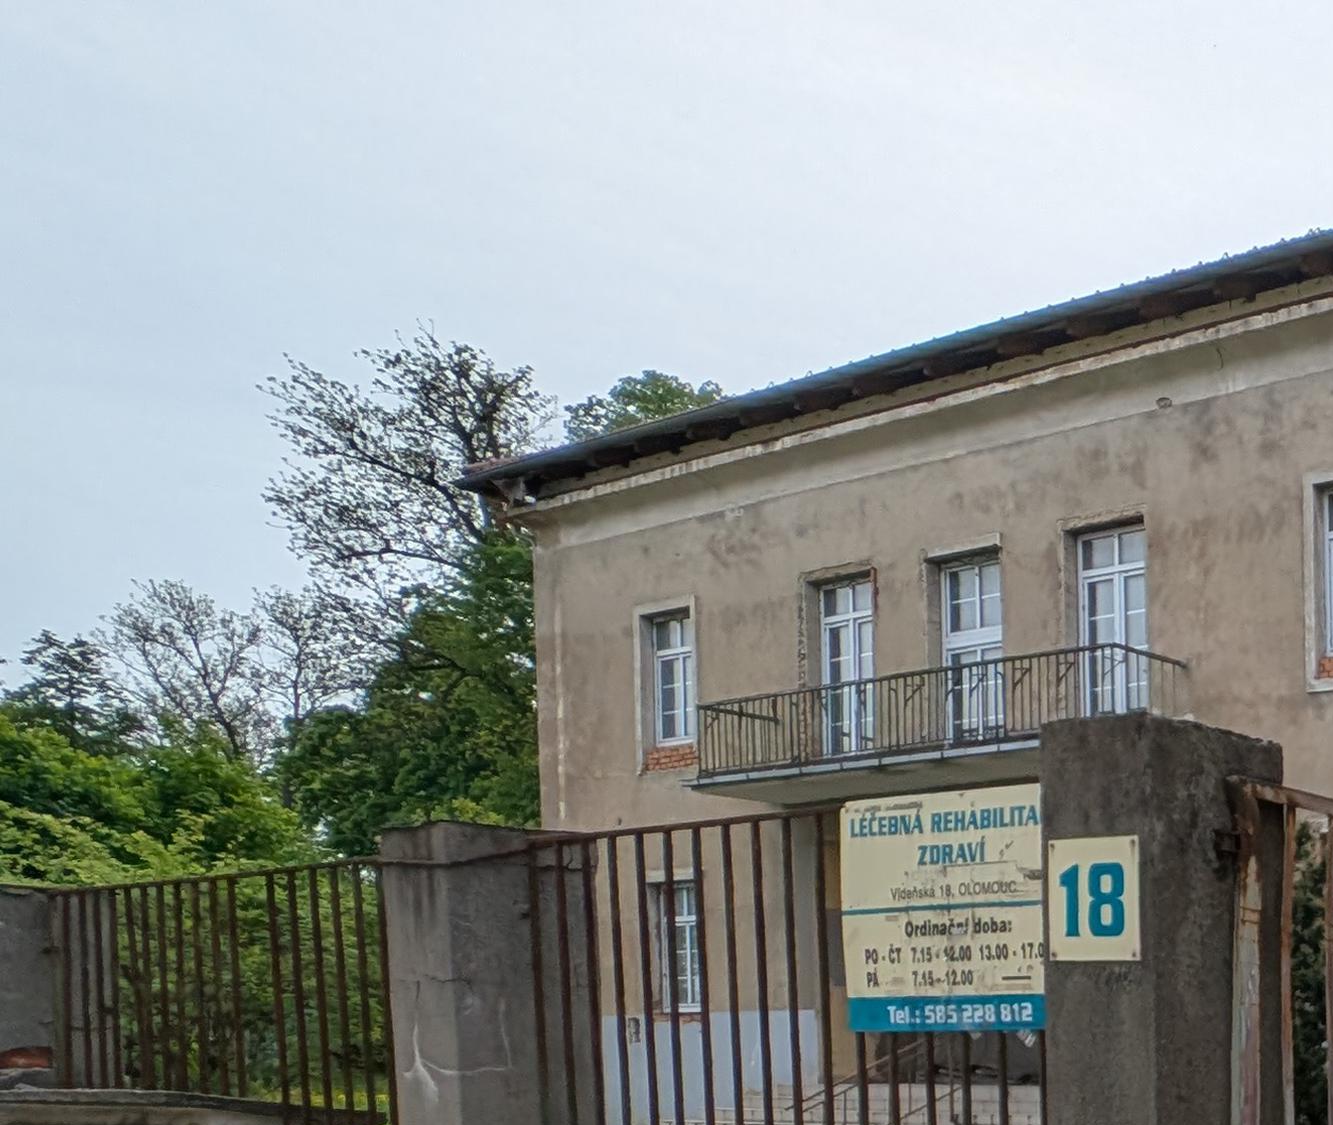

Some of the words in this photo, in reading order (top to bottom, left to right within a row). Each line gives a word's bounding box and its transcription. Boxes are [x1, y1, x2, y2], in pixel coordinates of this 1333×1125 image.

[850, 808, 923, 838] LÉČEBNÁ
[917, 835, 986, 866] ZDRAVÍ
[939, 884, 954, 898] 18,
[958, 880, 1018, 897] OLOMOUC
[1059, 862, 1125, 937] 18
[973, 916, 1012, 935] doba:
[865, 948, 878, 965] PO
[888, 944, 902, 964] ČT
[910, 946, 932, 964] 7.15
[943, 945, 972, 963] 12.00
[979, 943, 1008, 961] 13.00
[866, 967, 880, 988] PÁ
[912, 970, 933, 987] 7.15
[944, 969, 974, 987] 12.00
[887, 1005, 921, 1025] Tel.:
[924, 1004, 957, 1025] 585
[962, 1003, 996, 1024] 228
[1000, 1002, 1033, 1023] 812
